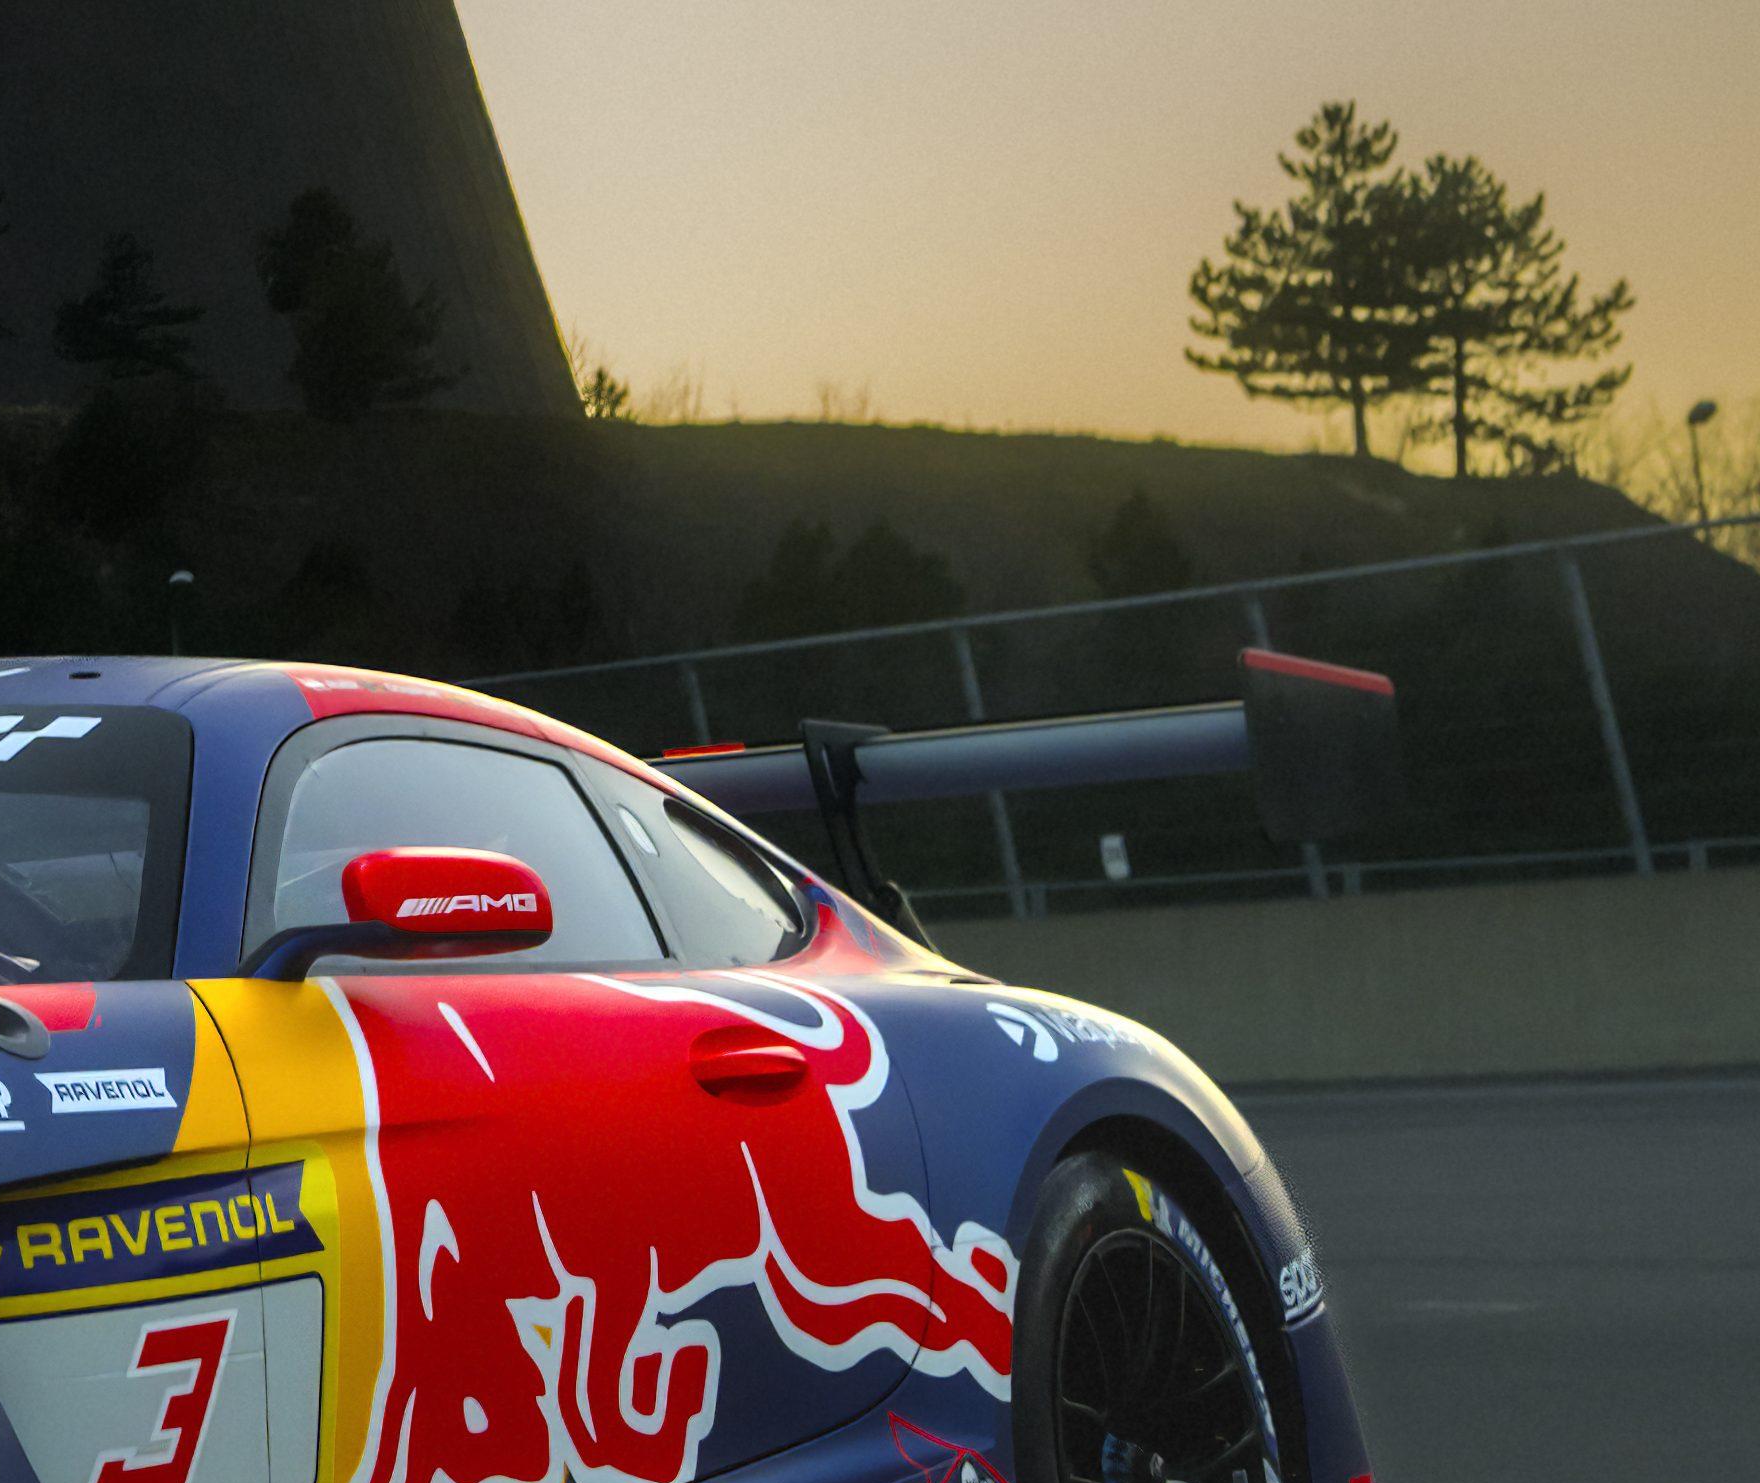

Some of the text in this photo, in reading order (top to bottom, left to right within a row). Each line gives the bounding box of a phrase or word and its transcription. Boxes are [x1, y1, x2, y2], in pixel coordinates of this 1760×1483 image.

[446, 893, 537, 914] AMG
[53, 1078, 166, 1103] RAVENOL
[15, 1191, 296, 1269] RAVENOL
